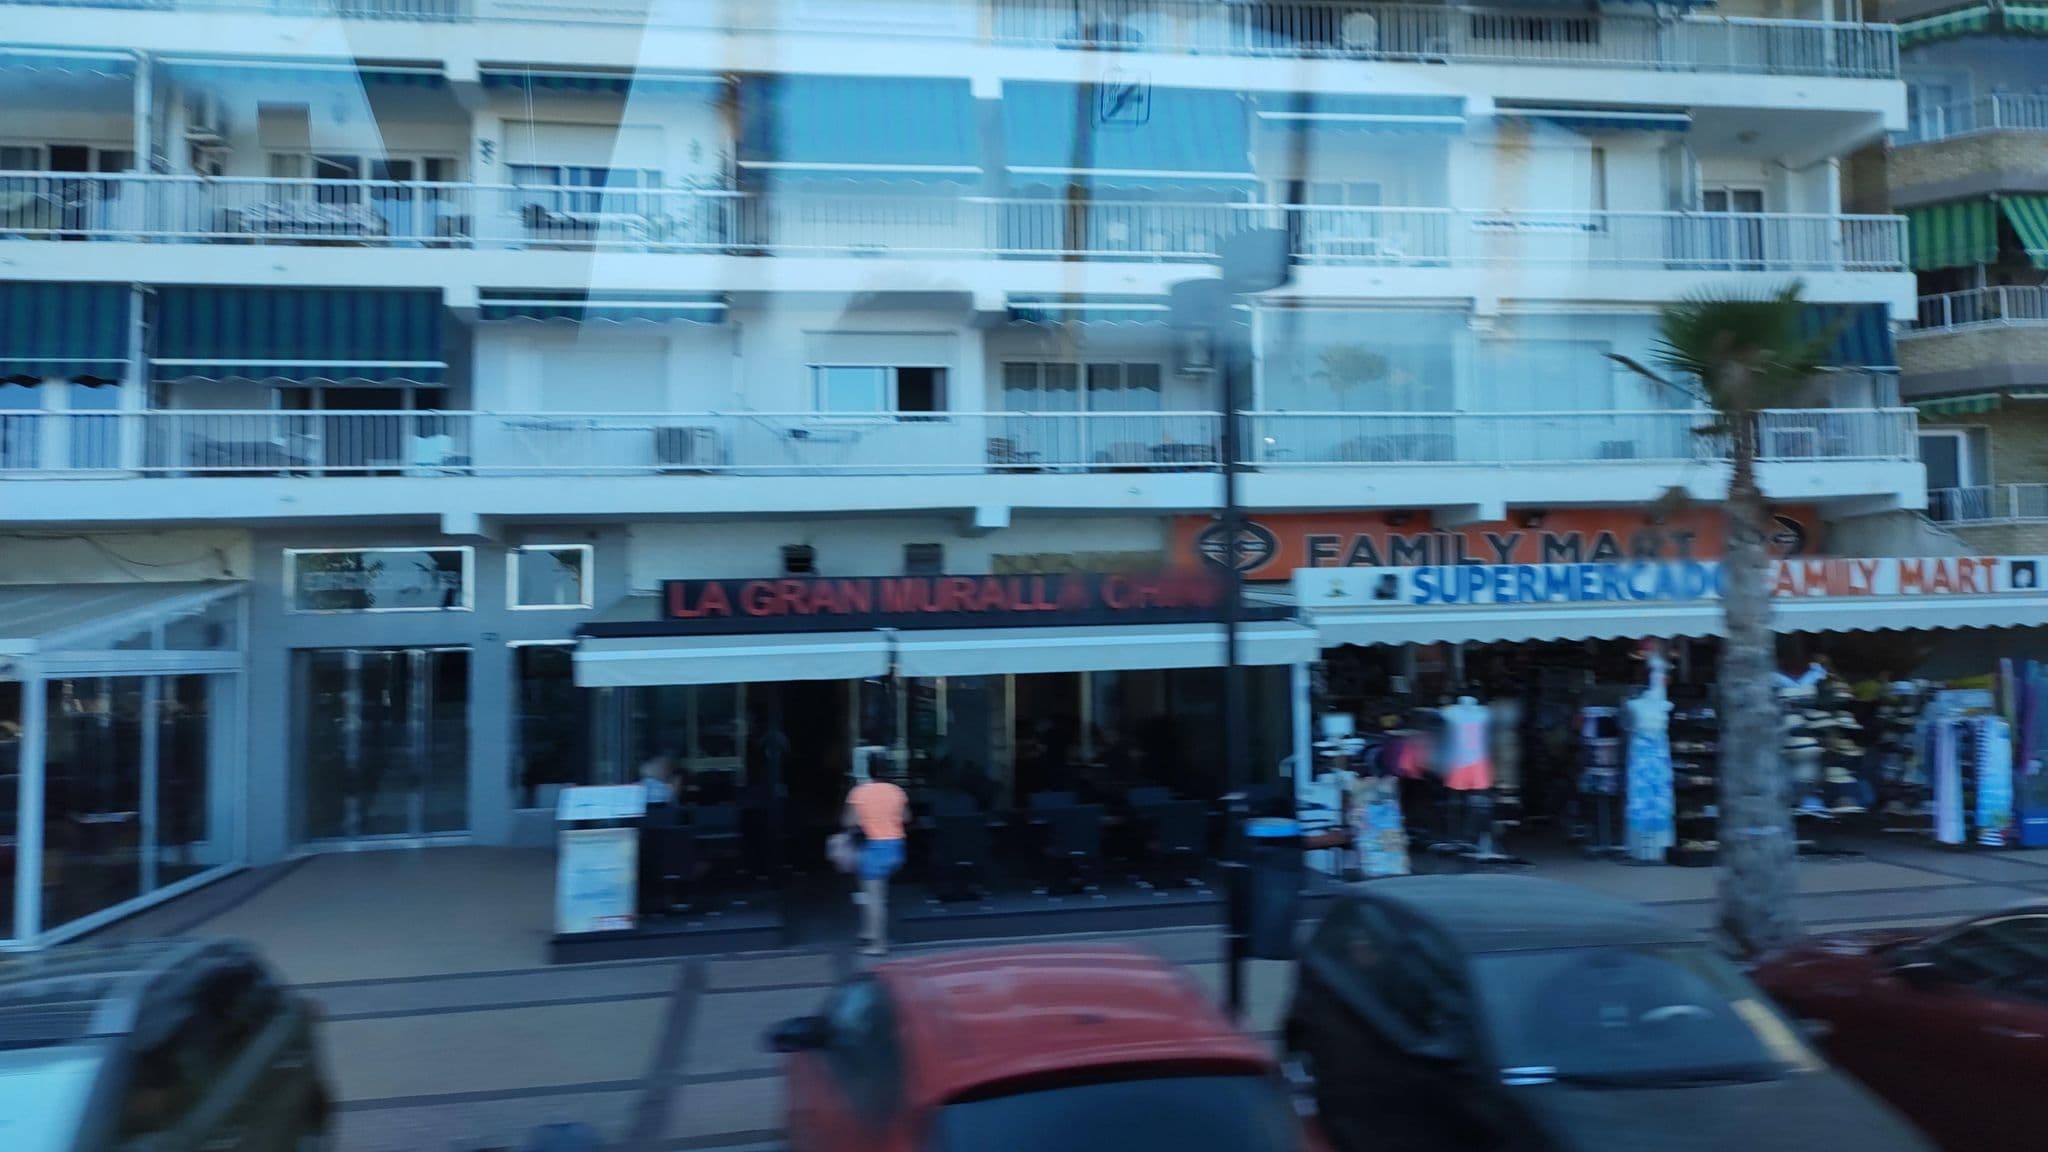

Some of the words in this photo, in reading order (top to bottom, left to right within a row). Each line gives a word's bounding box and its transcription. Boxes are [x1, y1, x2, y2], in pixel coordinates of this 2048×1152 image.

[1308, 532, 1523, 567] FAMILY
[1541, 531, 1698, 563] MART
[672, 581, 731, 618] LA
[744, 579, 872, 616] GRAN
[878, 575, 1089, 613] MURALLA
[1769, 559, 1879, 597] AMILY
[1899, 557, 1999, 594] MART
